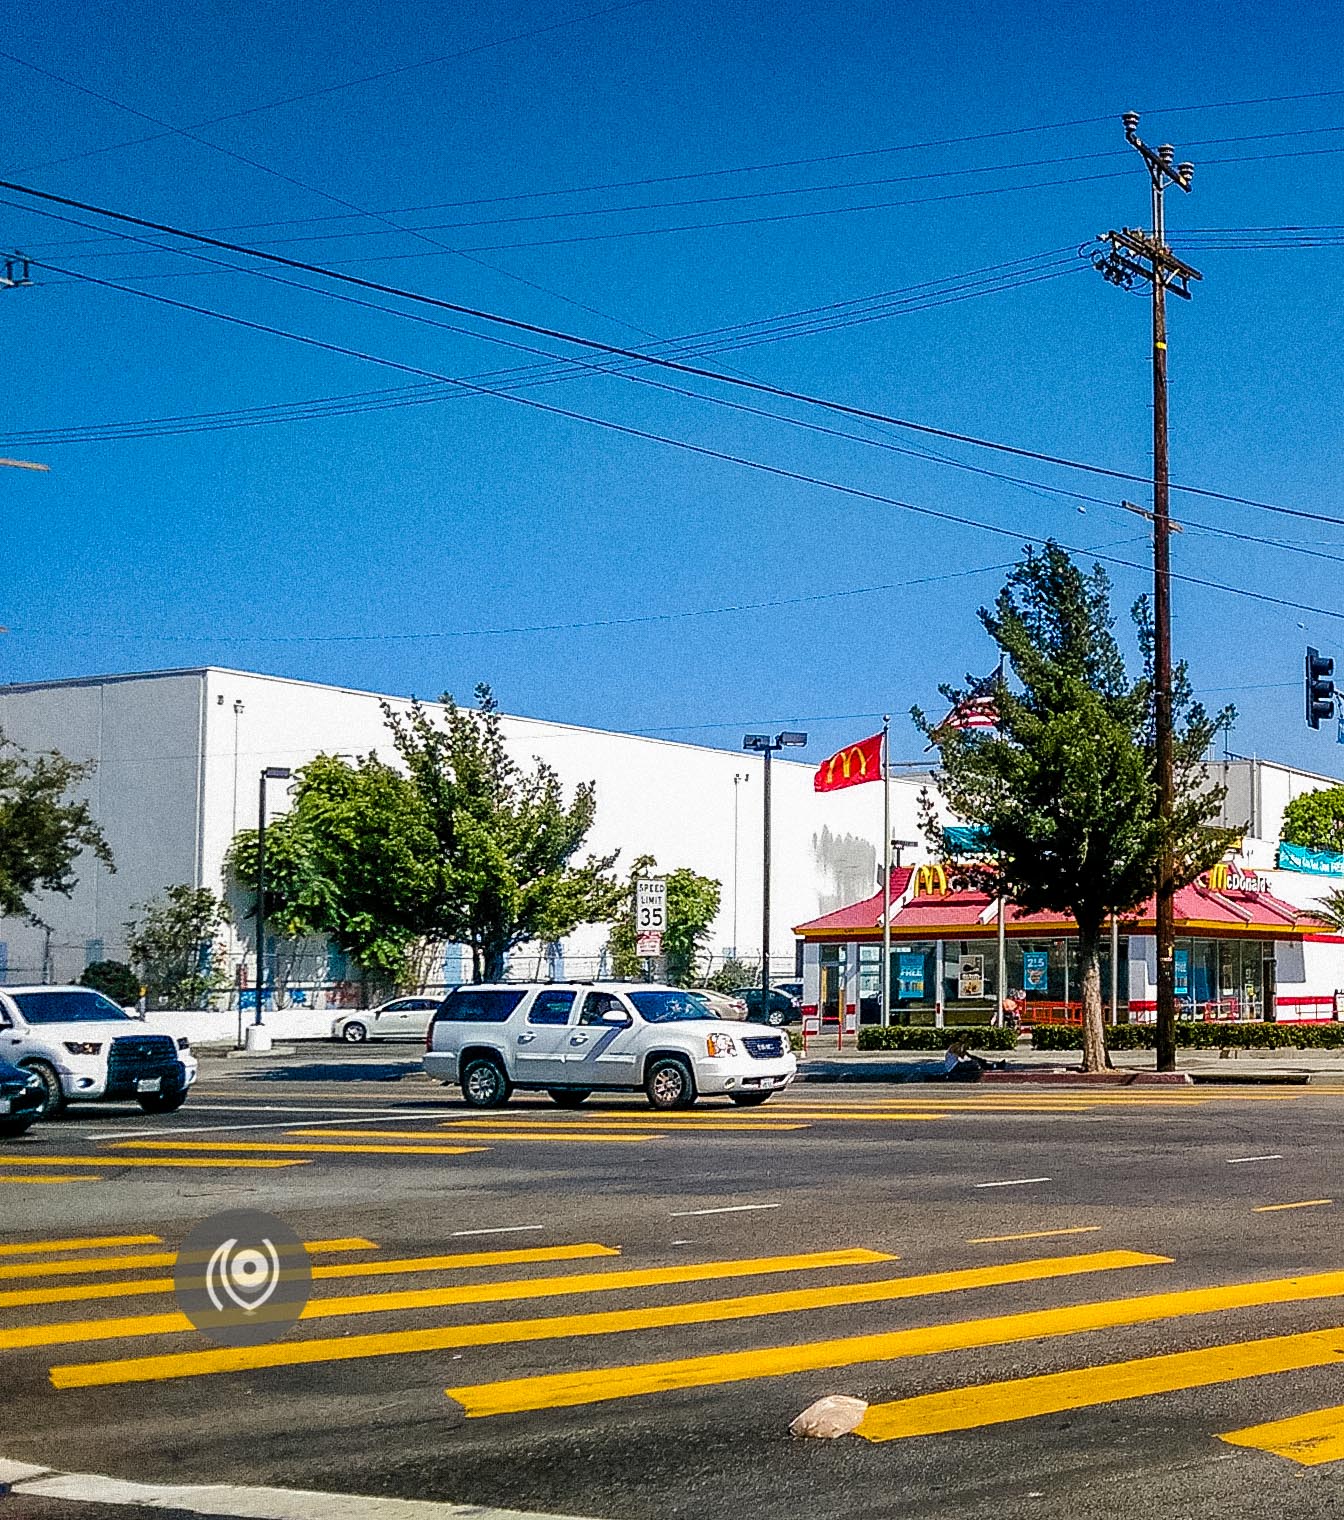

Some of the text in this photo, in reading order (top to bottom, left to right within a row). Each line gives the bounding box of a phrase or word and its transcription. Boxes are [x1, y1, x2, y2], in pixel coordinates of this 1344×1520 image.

[639, 883, 665, 893] SPEED
[641, 896, 663, 904] LIMIT
[641, 907, 663, 926] 35
